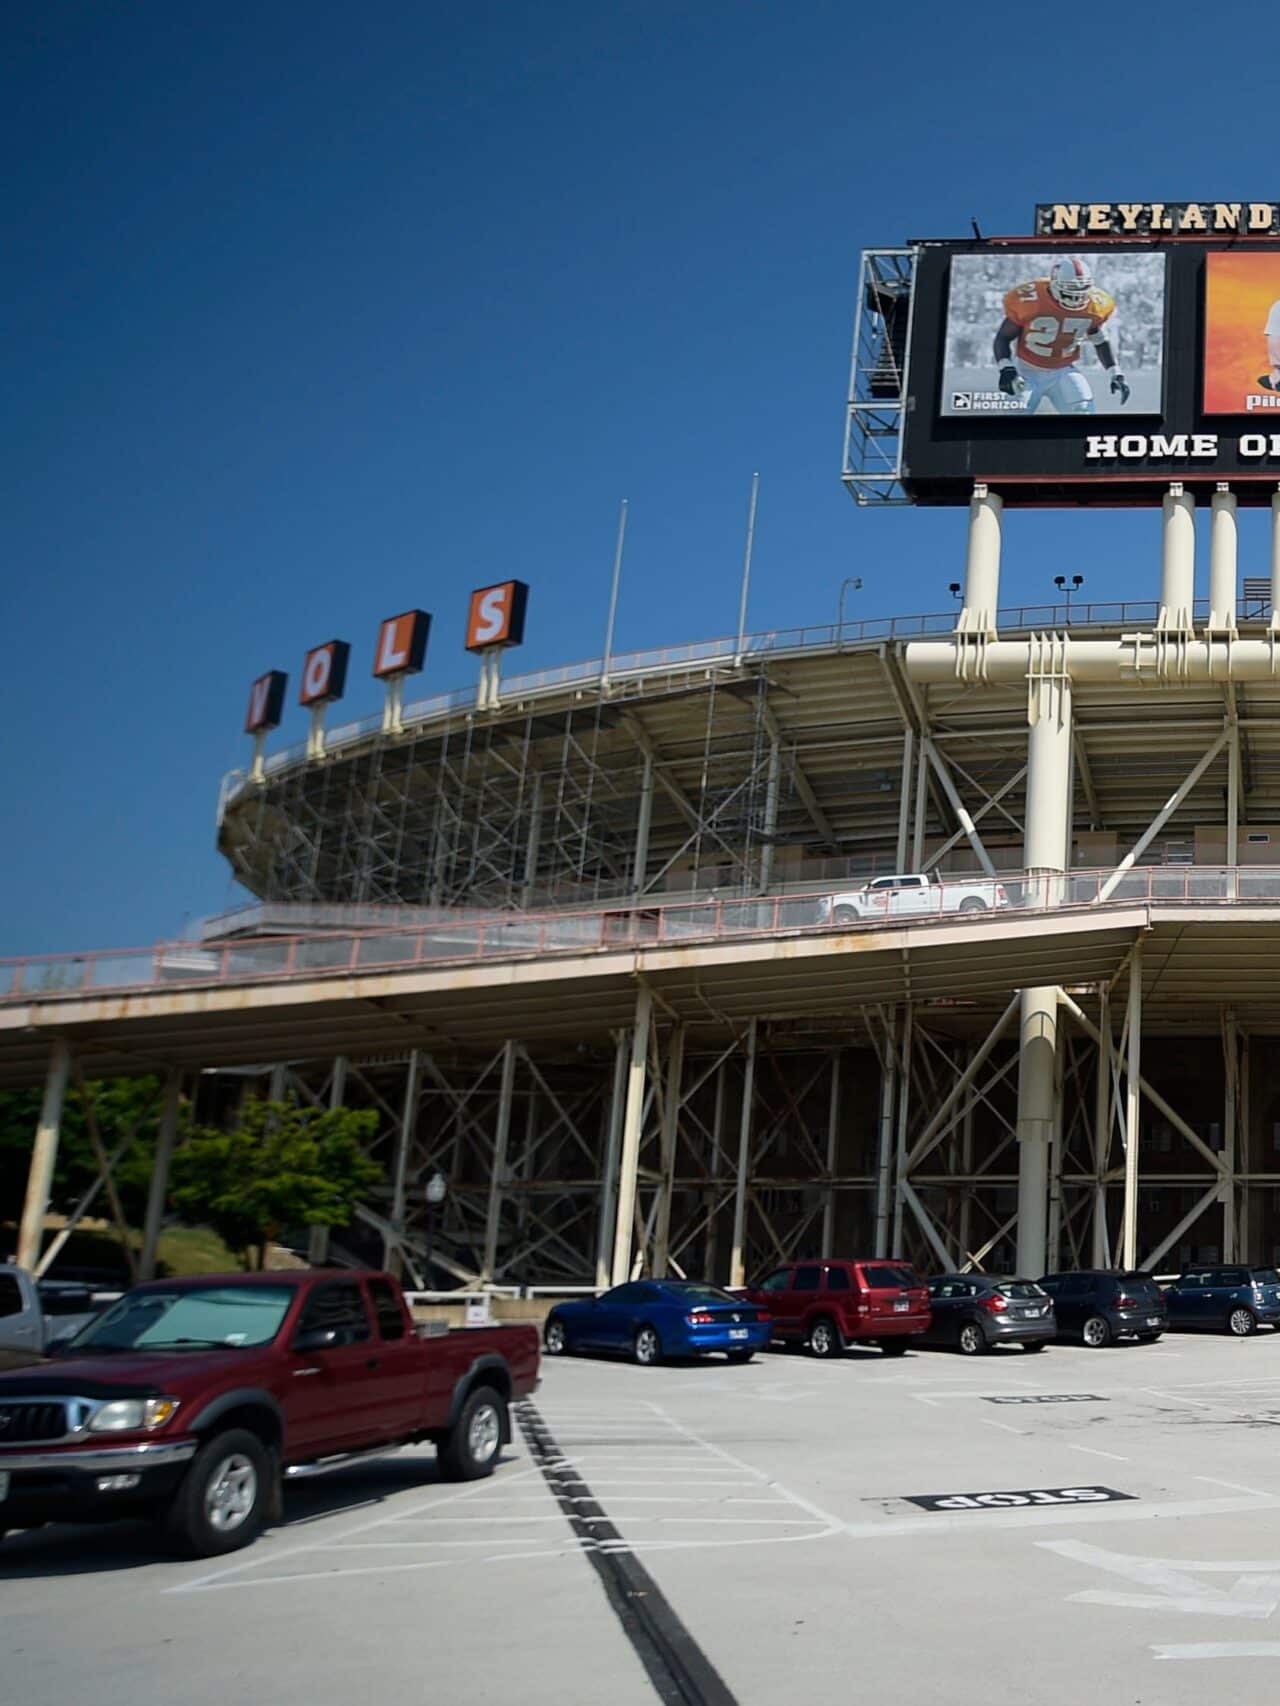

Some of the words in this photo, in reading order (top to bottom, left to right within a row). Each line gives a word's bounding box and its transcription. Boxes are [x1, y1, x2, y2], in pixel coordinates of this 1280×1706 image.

[1052, 203, 1273, 230] NEYLAND
[1025, 316, 1093, 358] 27
[973, 392, 1007, 400] FIRST
[973, 401, 1028, 409] HORIZON
[1086, 435, 1218, 458] HOME
[935, 1489, 1110, 1509] STOP
